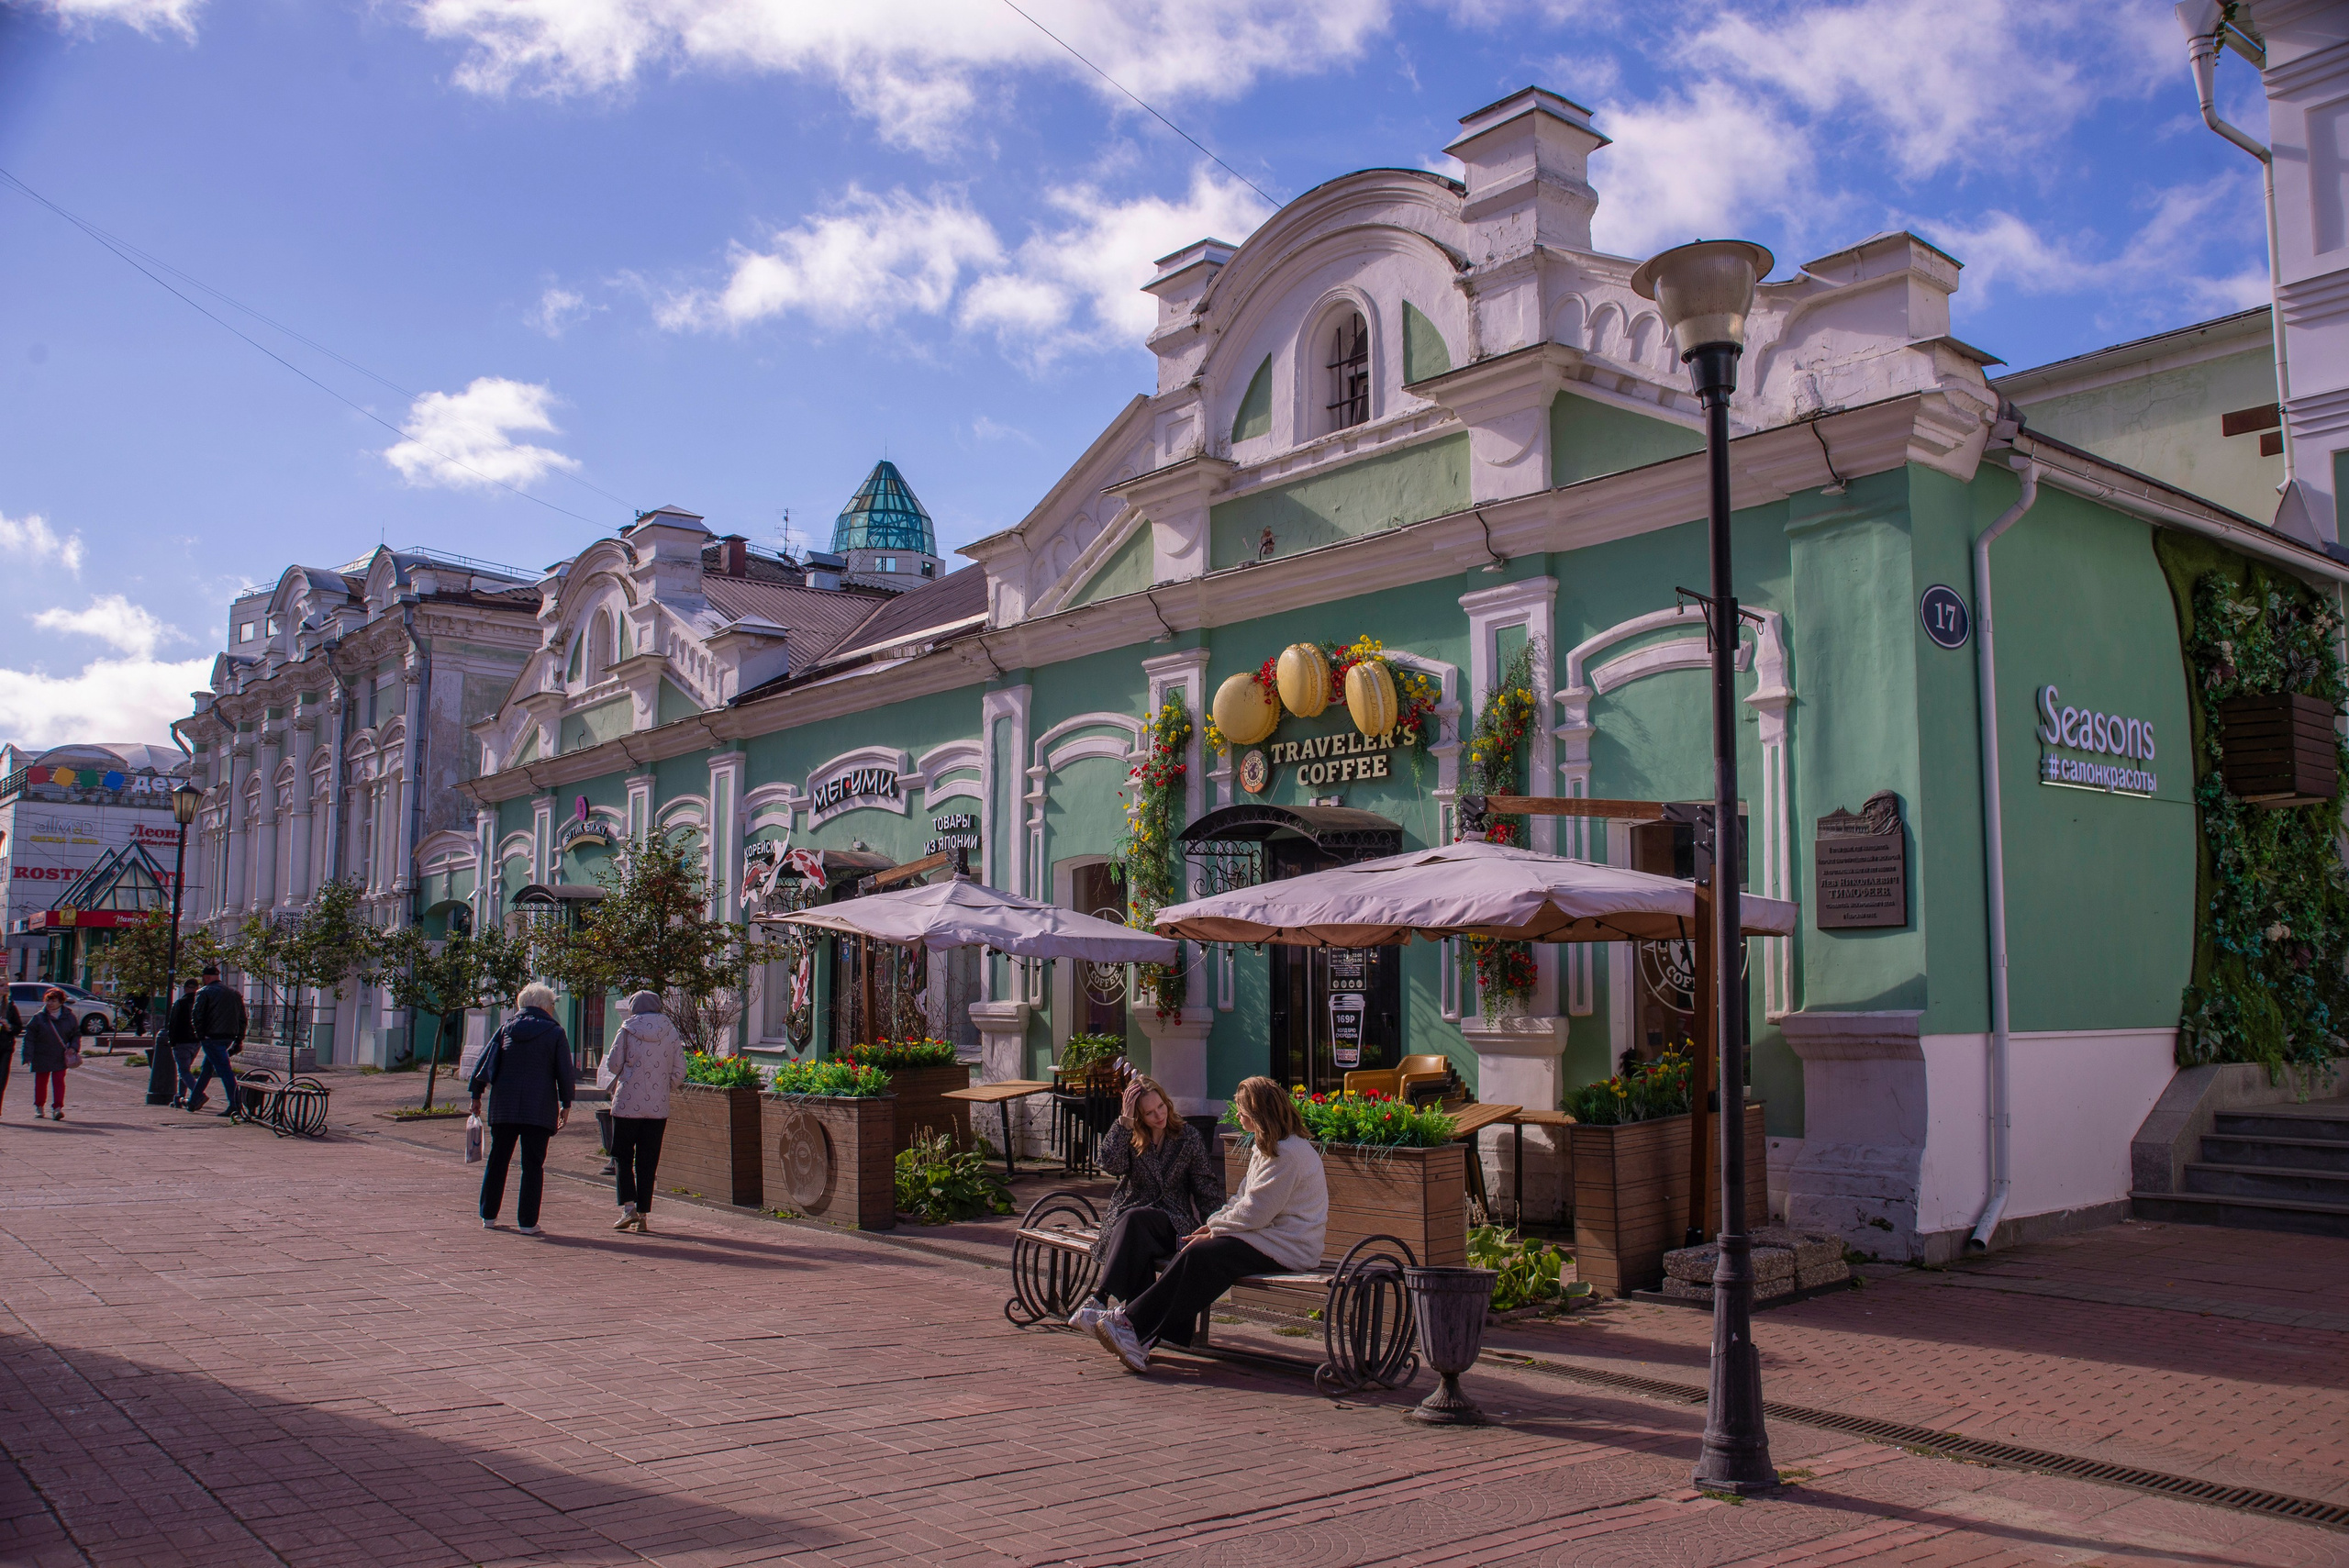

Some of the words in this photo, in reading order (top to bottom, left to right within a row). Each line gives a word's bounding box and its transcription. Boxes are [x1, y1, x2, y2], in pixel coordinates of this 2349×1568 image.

[1934, 601, 1956, 632] 17
[2038, 684, 2155, 761] Seasons
[1297, 754, 1388, 786] COFFEE
[2047, 752, 2157, 793] #салонкрасоты
[813, 769, 894, 816] МЕГУМИ
[564, 822, 584, 843] БУТИК
[585, 822, 607, 835] БИЖУ
[931, 813, 971, 831] ТОВАРЫ
[923, 839, 936, 855] ИЗ
[938, 834, 978, 851] ЯПОНИИ
[1090, 970, 1120, 987] COFFEE
[1665, 965, 1696, 989] COF
